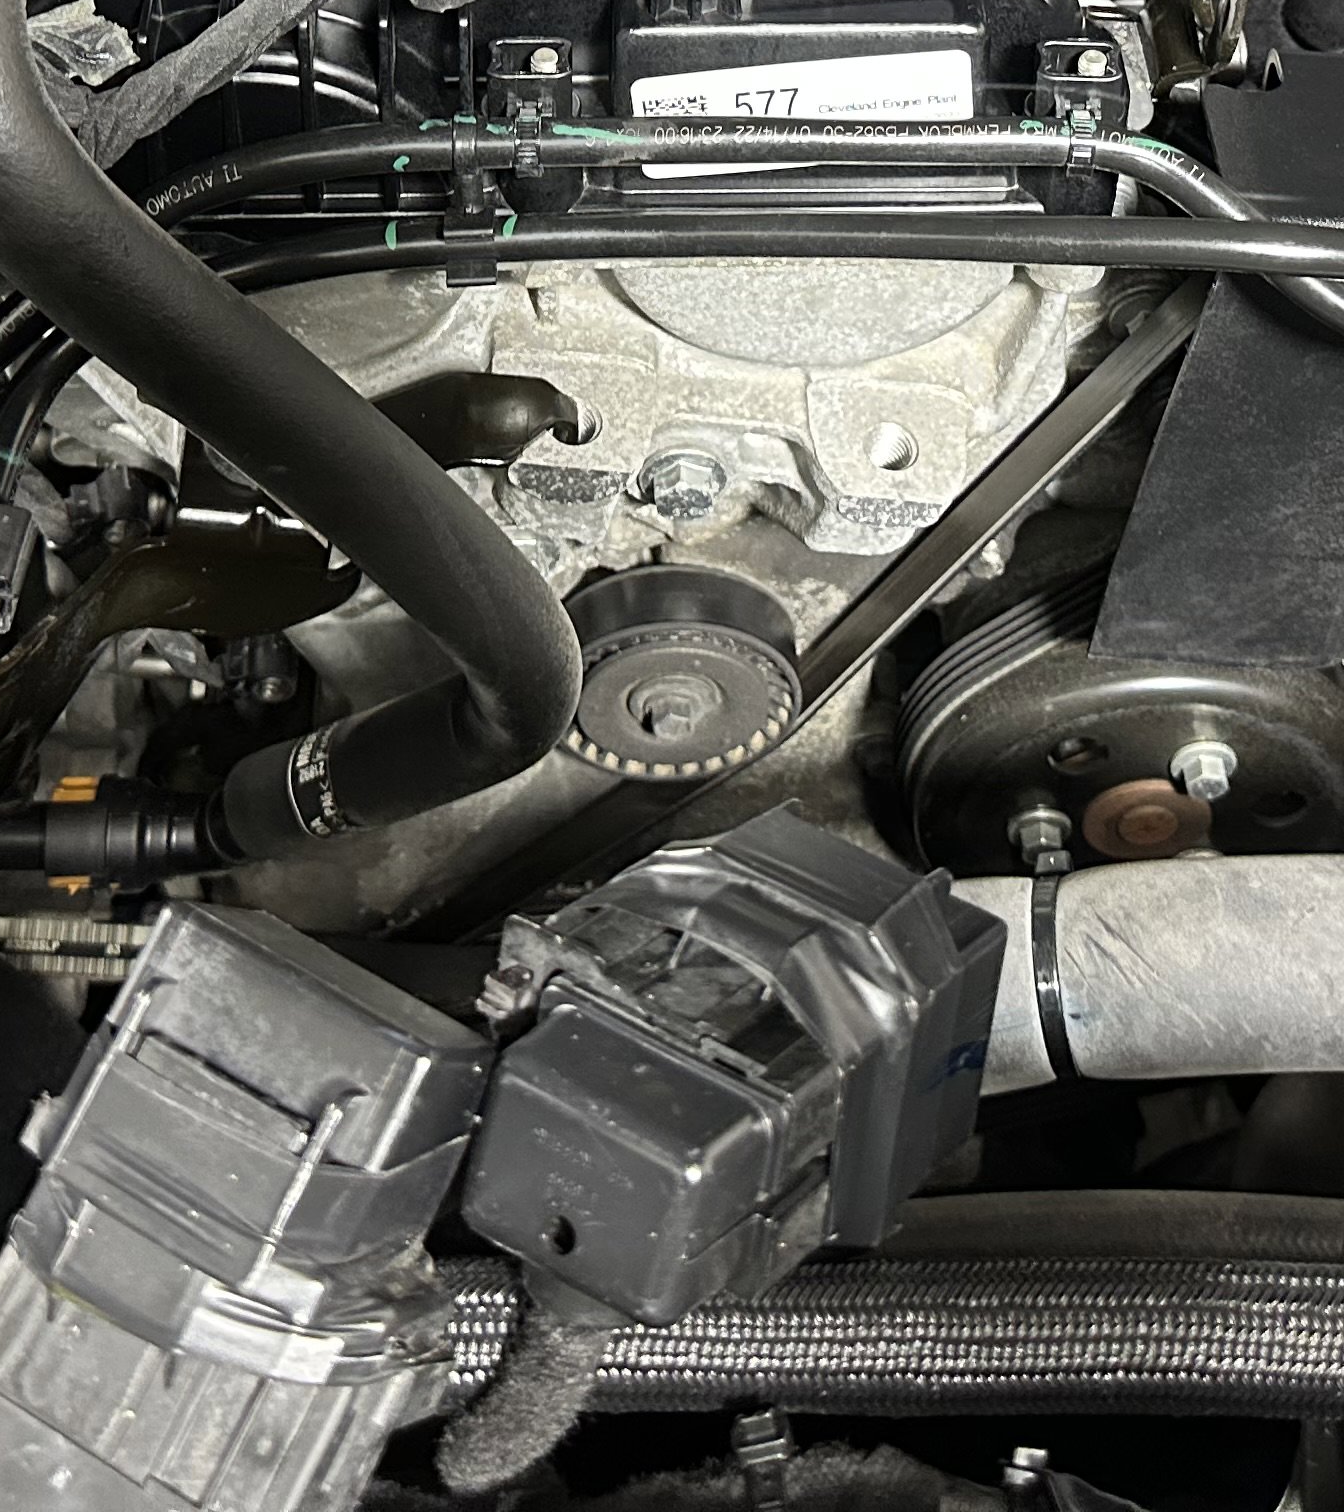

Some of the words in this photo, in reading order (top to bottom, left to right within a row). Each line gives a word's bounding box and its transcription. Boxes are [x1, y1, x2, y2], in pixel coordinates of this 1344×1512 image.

[735, 88, 799, 116] 577
[818, 99, 878, 114] Cleveland
[882, 97, 922, 110] Engine
[927, 94, 957, 105] Plant
[221, 163, 244, 185] TI
[146, 169, 215, 217] AUTOMO
